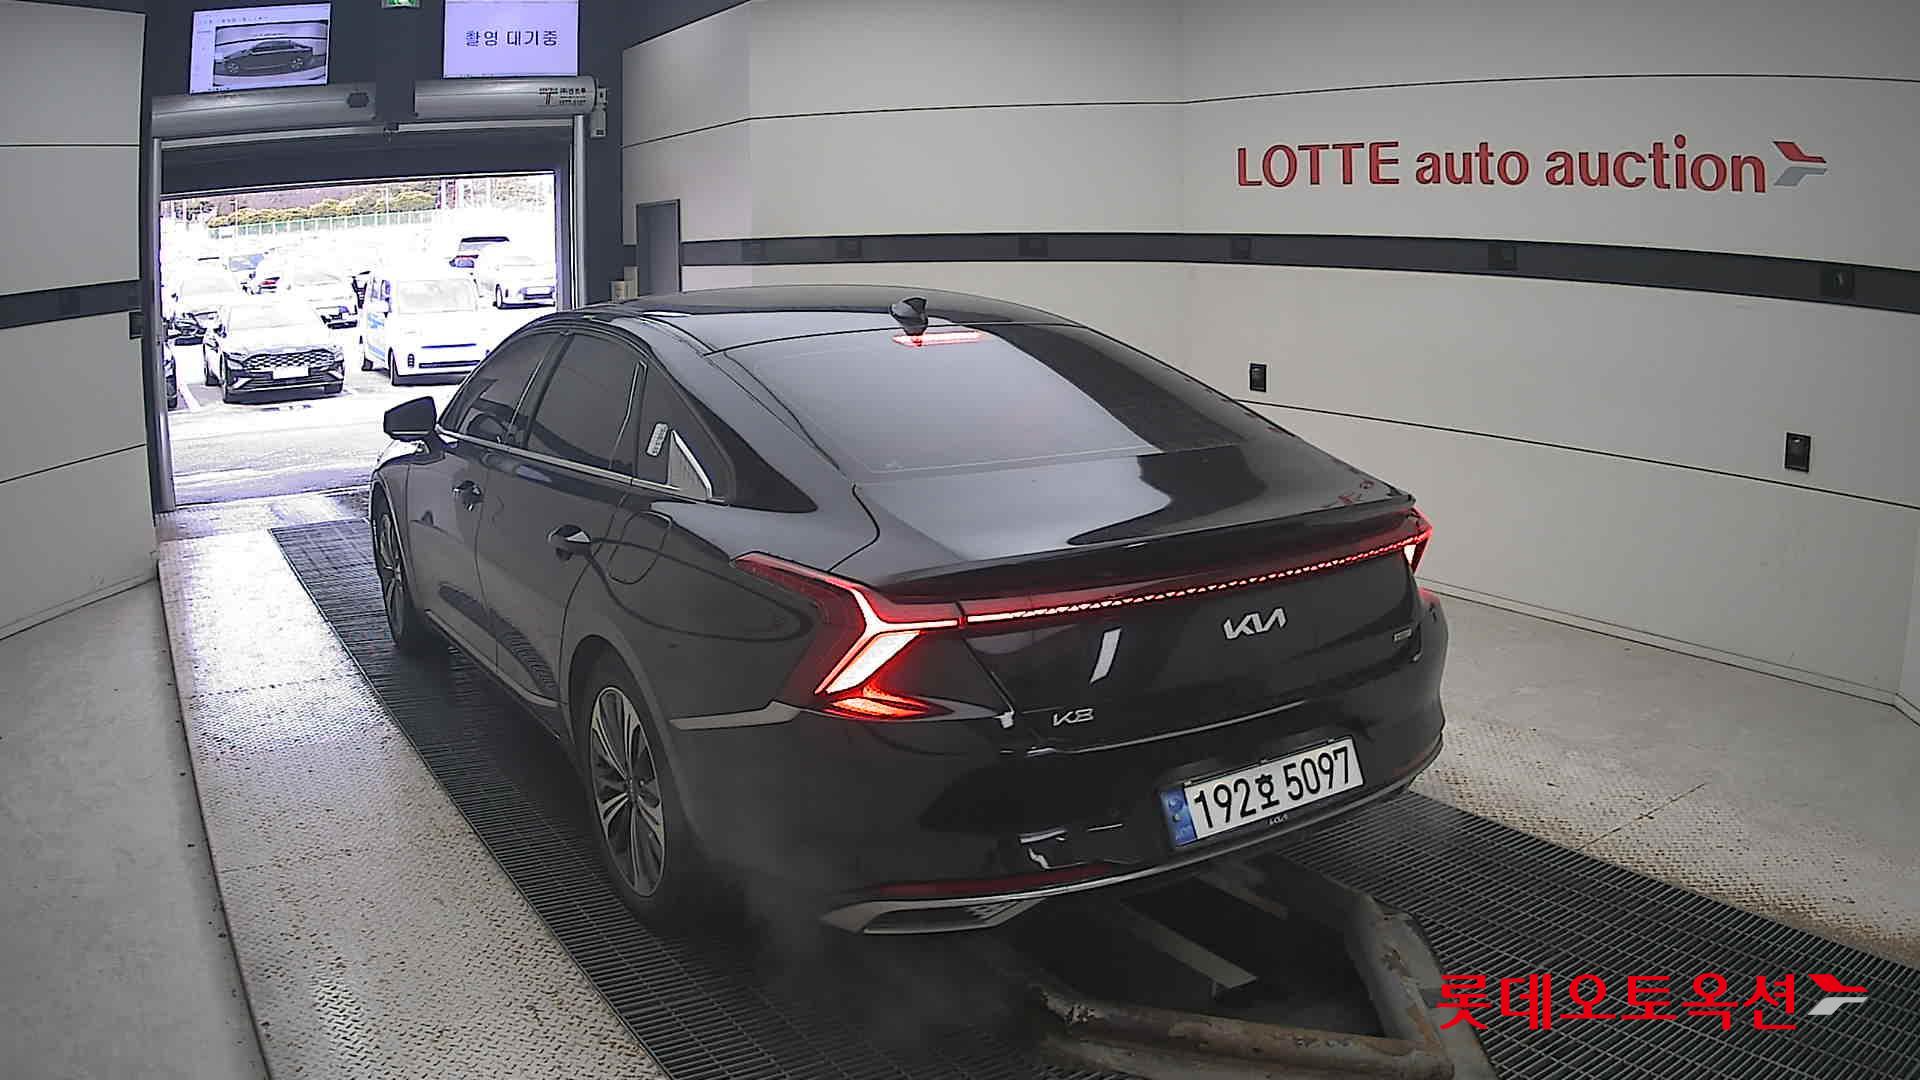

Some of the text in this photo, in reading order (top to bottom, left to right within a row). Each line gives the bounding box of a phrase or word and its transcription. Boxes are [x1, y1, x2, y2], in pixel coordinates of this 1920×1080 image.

[466, 30, 498, 47] 촬영
[1237, 134, 1766, 193] LOTTE auto auction
[1224, 607, 1287, 641] KIA
[1052, 708, 1095, 728] K8
[1193, 746, 1350, 829] 192호 5097
